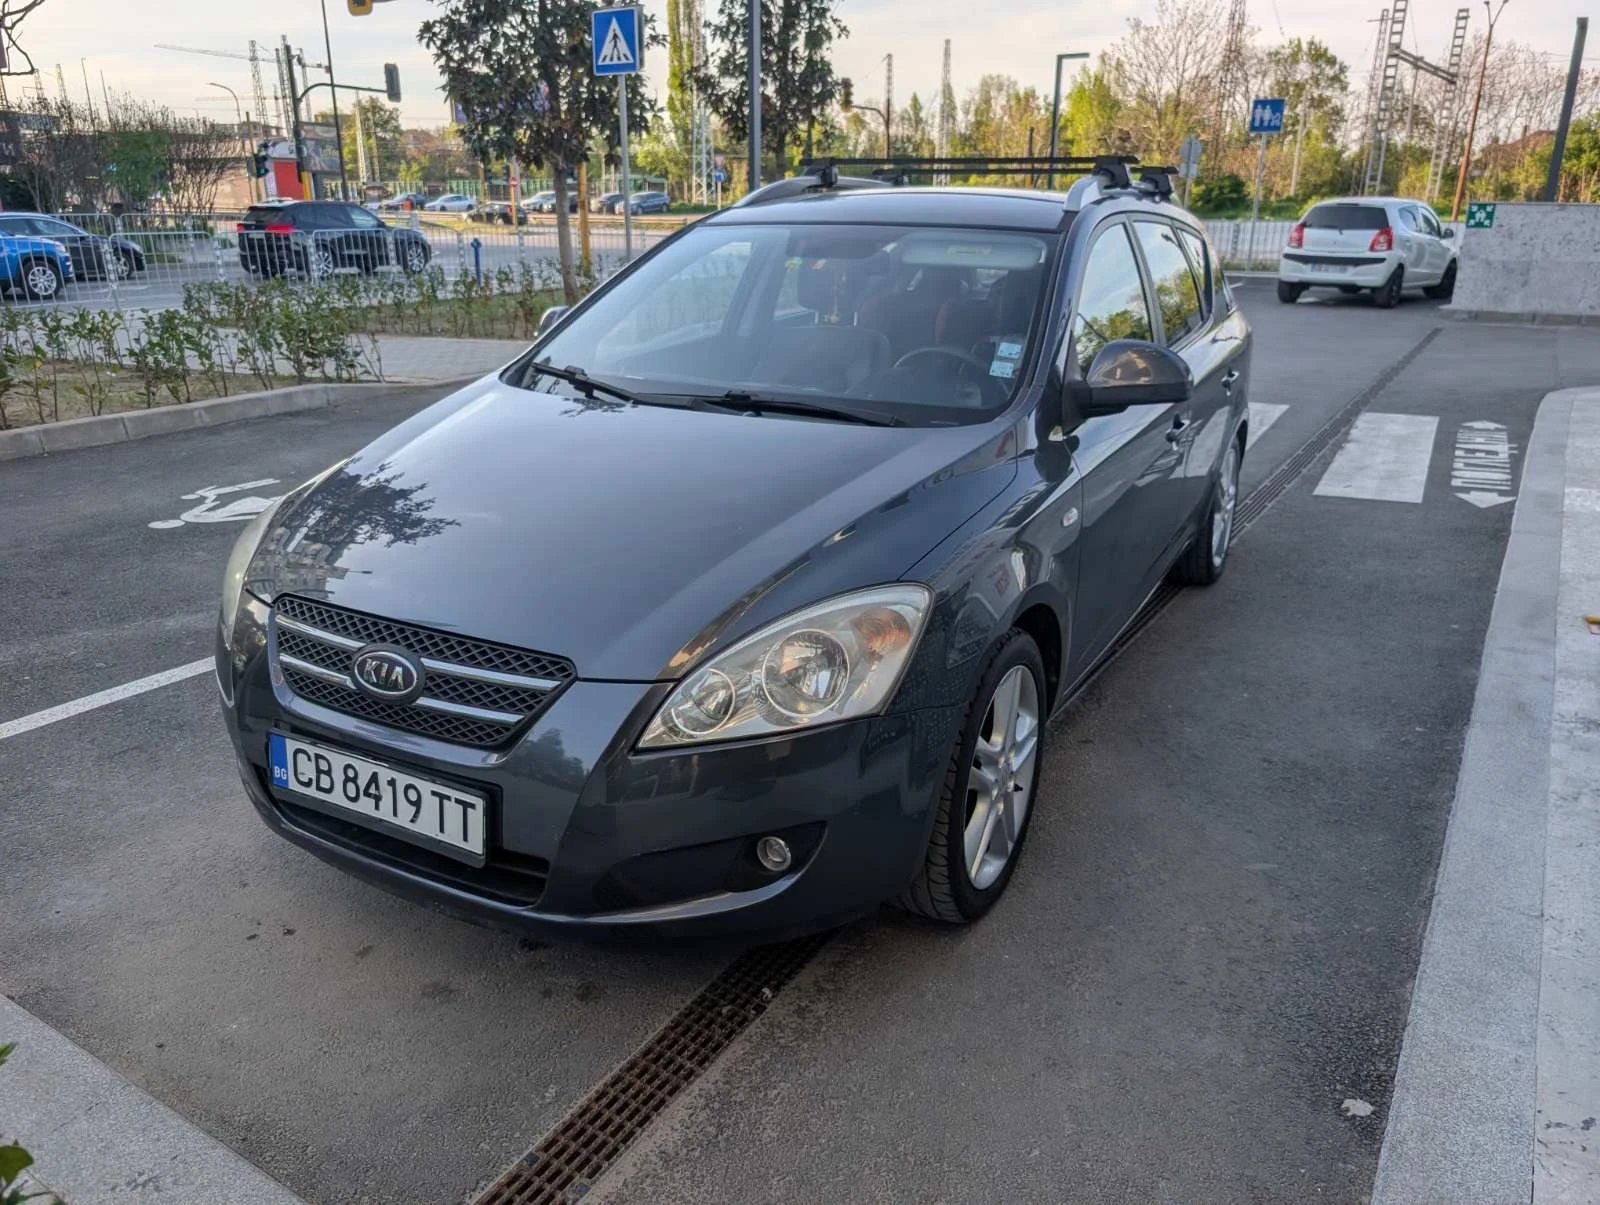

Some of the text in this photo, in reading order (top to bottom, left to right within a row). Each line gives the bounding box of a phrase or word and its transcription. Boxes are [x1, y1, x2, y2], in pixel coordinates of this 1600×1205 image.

[364, 658, 405, 690] KIA
[274, 766, 288, 780] BG
[292, 748, 476, 842] CB 8419 TT
